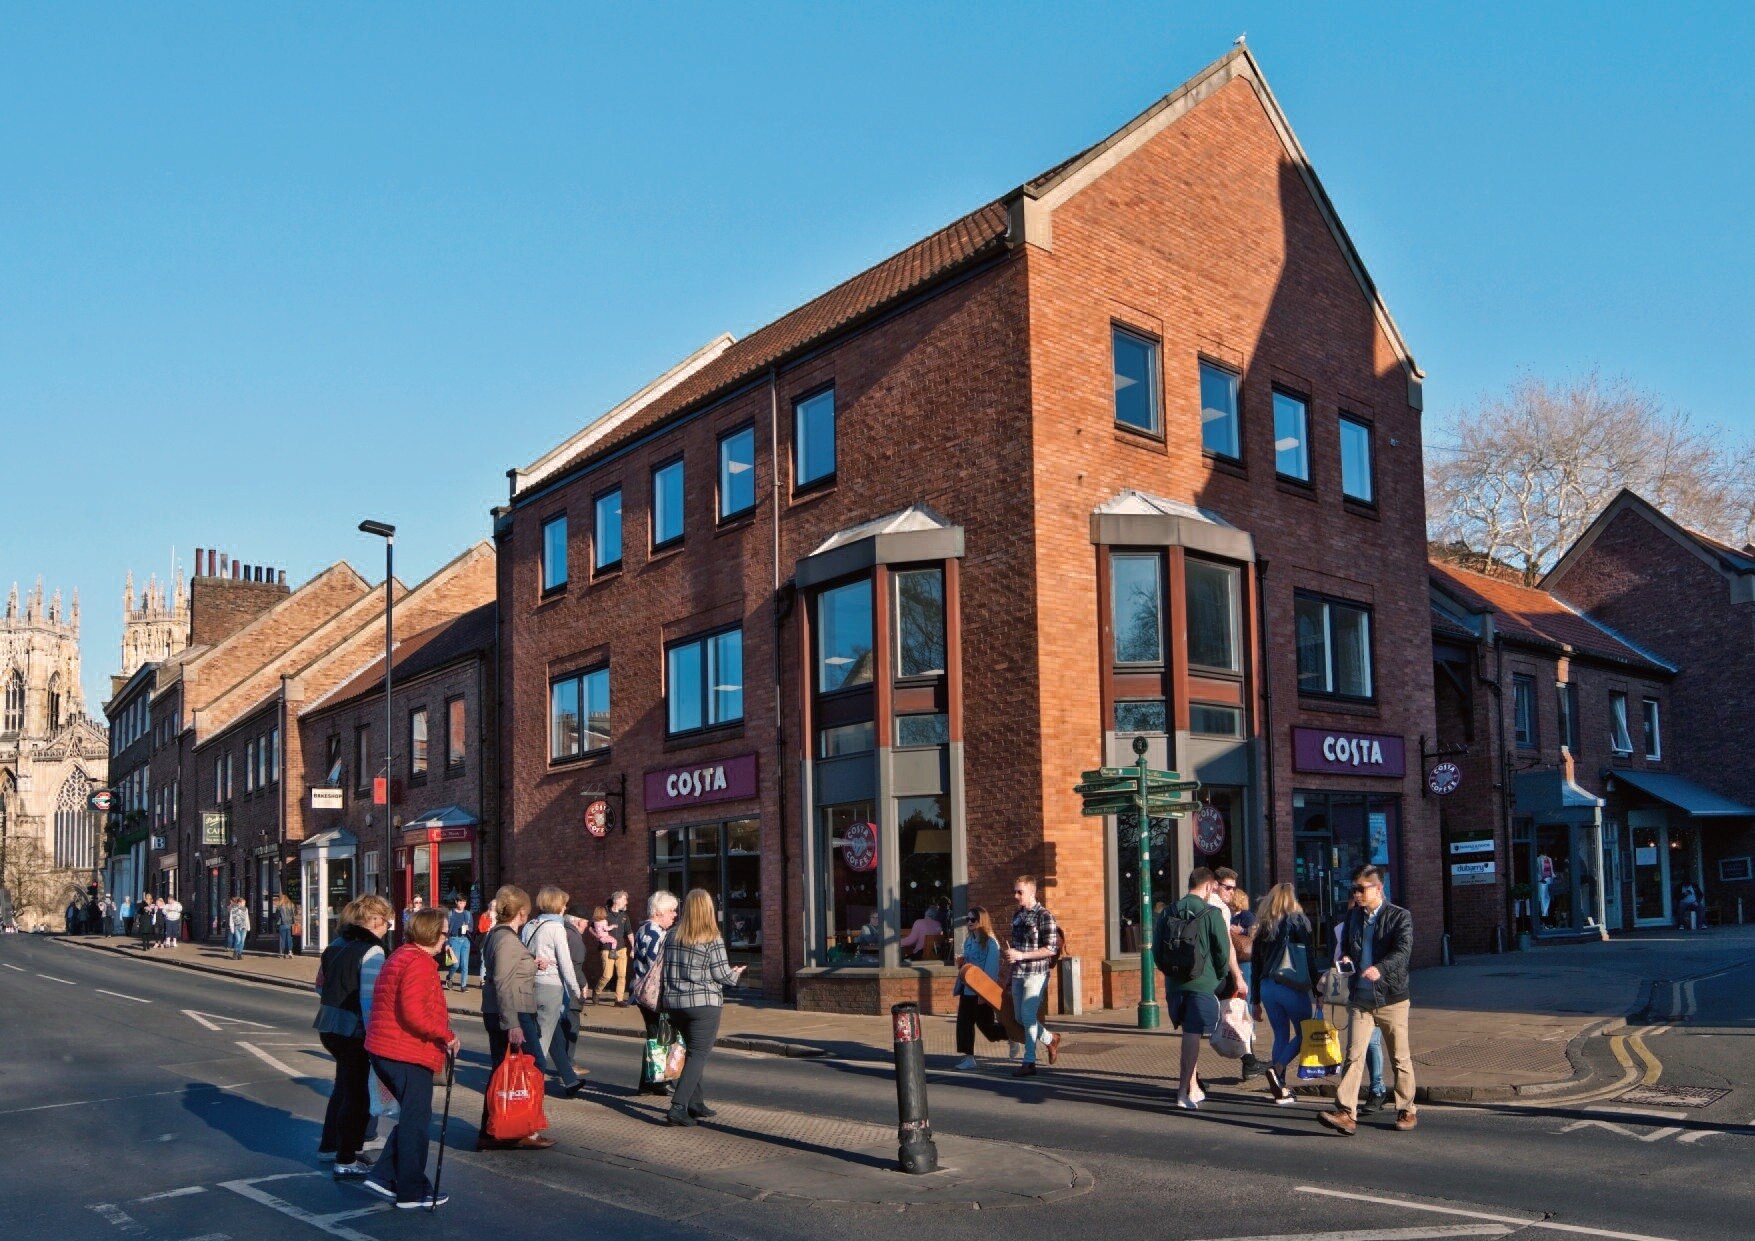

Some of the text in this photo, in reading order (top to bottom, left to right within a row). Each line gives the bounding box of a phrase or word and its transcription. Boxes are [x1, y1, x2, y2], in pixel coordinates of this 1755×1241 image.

[1323, 736, 1383, 766] COSTA
[1434, 764, 1456, 774] COSTA
[666, 765, 727, 797] COSTA
[1431, 781, 1457, 793] COFFEE
[1198, 808, 1218, 822] COSTA
[847, 825, 869, 839] COSTA
[1198, 834, 1223, 850] COFFEE
[846, 850, 873, 866] COFFEE
[1457, 864, 1485, 873] dubarry
